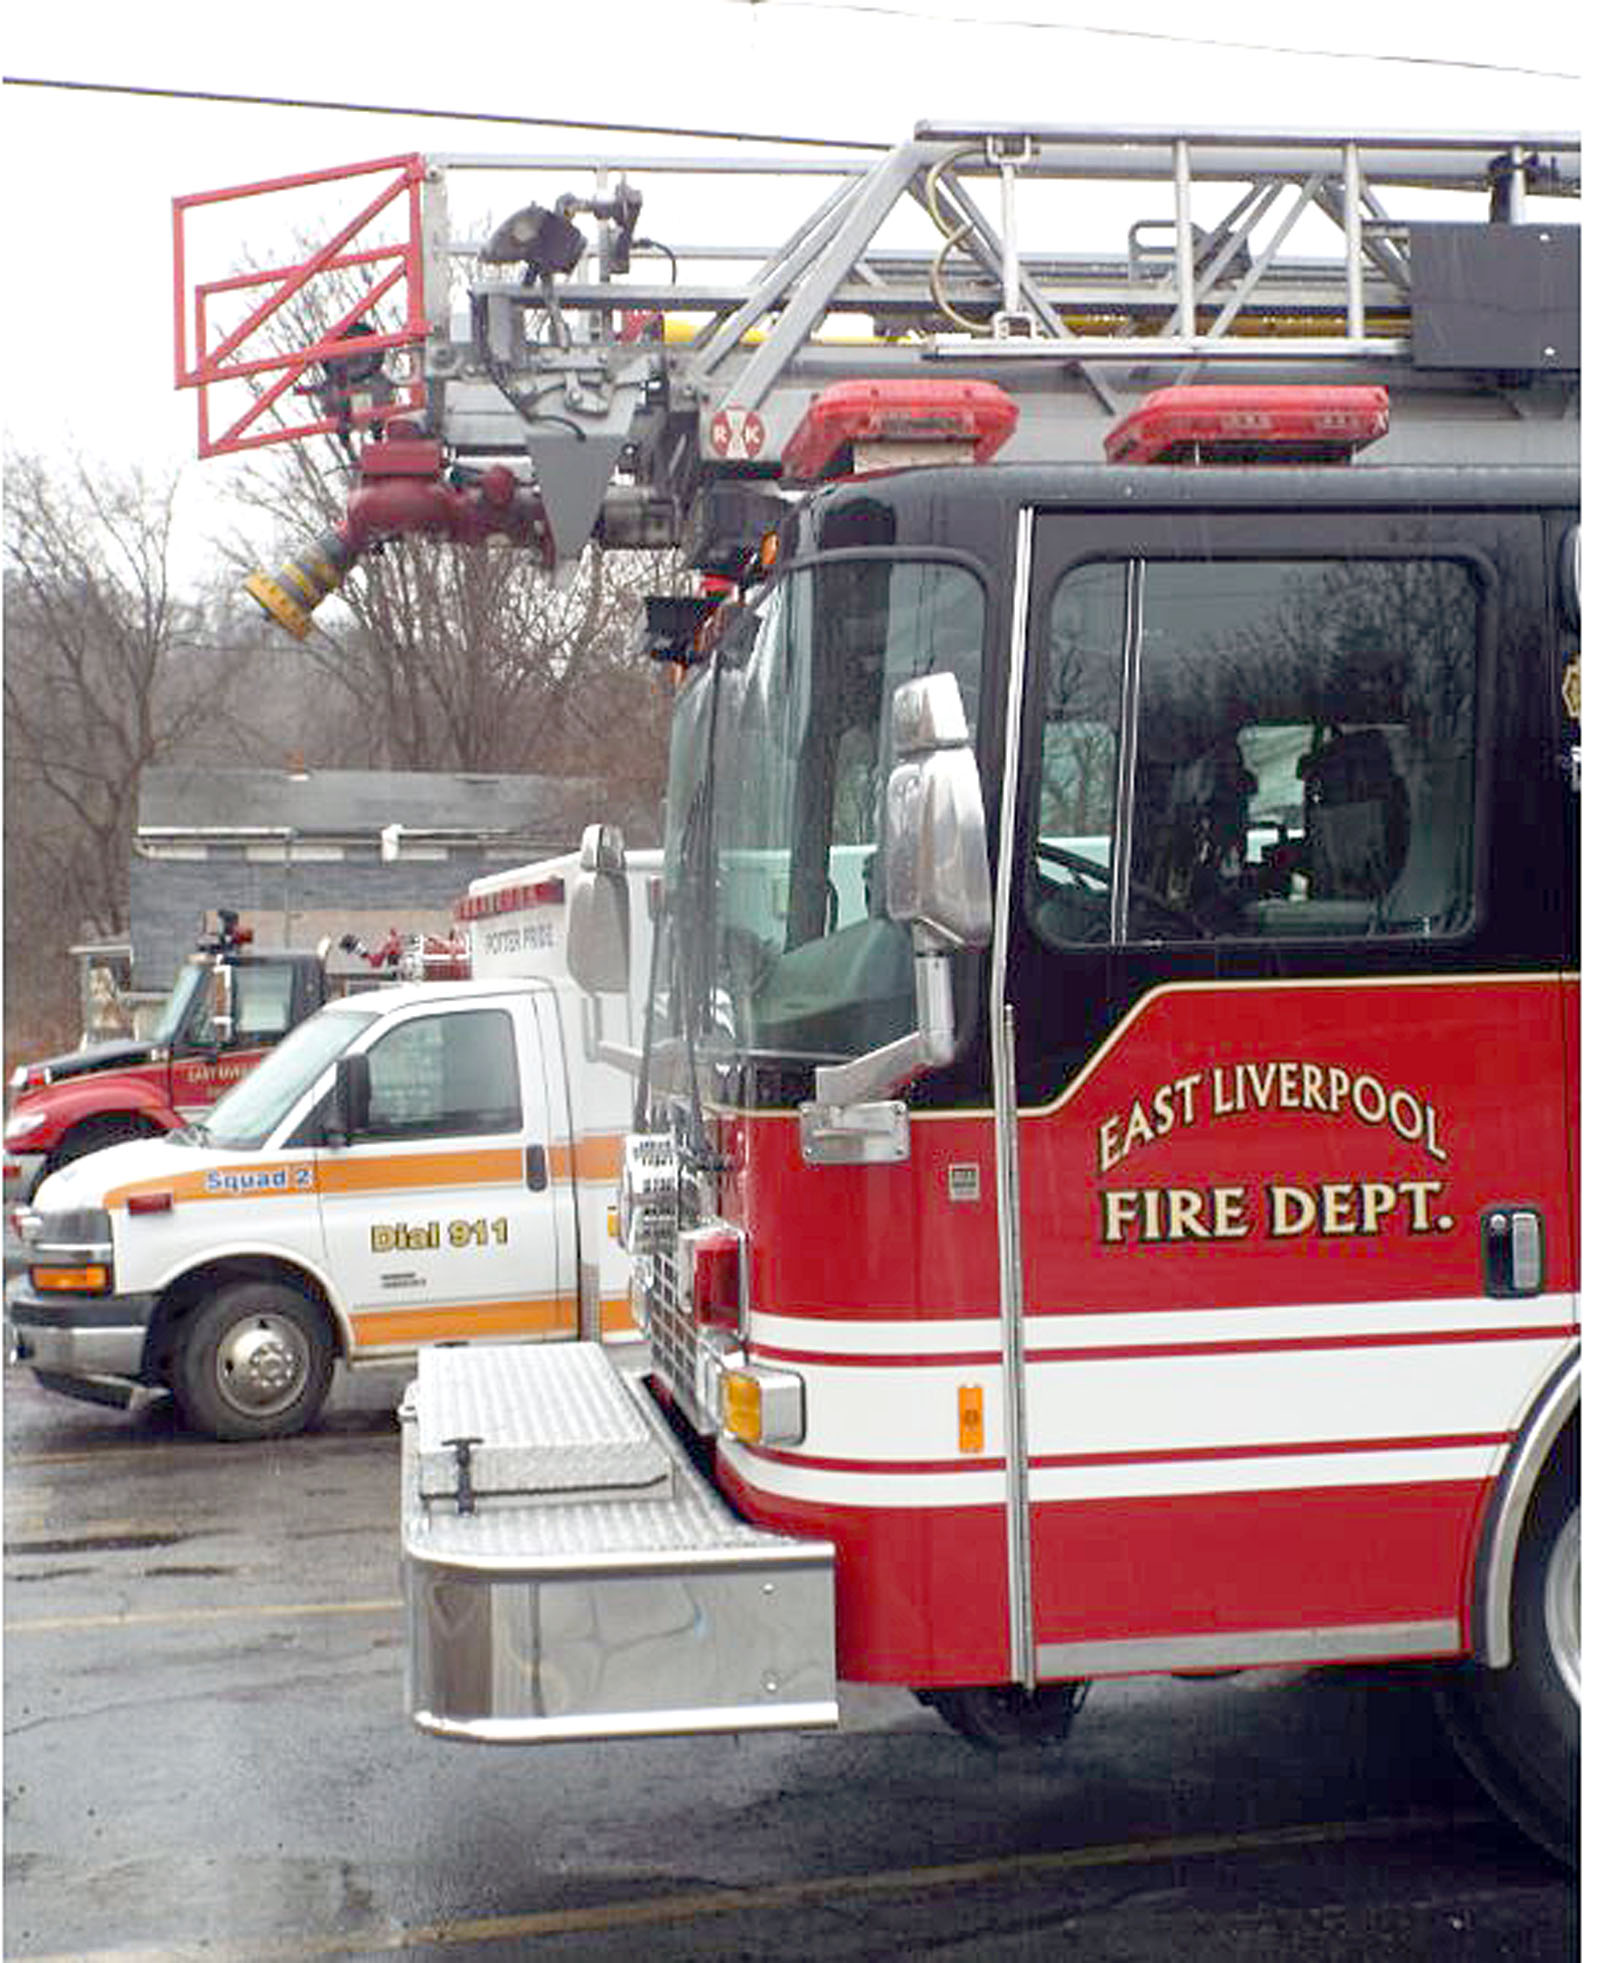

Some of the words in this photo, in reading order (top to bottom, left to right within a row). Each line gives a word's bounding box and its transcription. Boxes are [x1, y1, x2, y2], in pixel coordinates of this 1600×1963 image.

[1099, 1074, 1202, 1173] EAST
[1212, 1062, 1447, 1161] LIVERPOOL
[207, 1169, 286, 1193] Squad
[295, 1168, 312, 1188] 2
[371, 1221, 440, 1252] Dial
[448, 1217, 508, 1248] 911
[1104, 1187, 1248, 1241] FIRE
[1269, 1181, 1454, 1236] DEPT.
